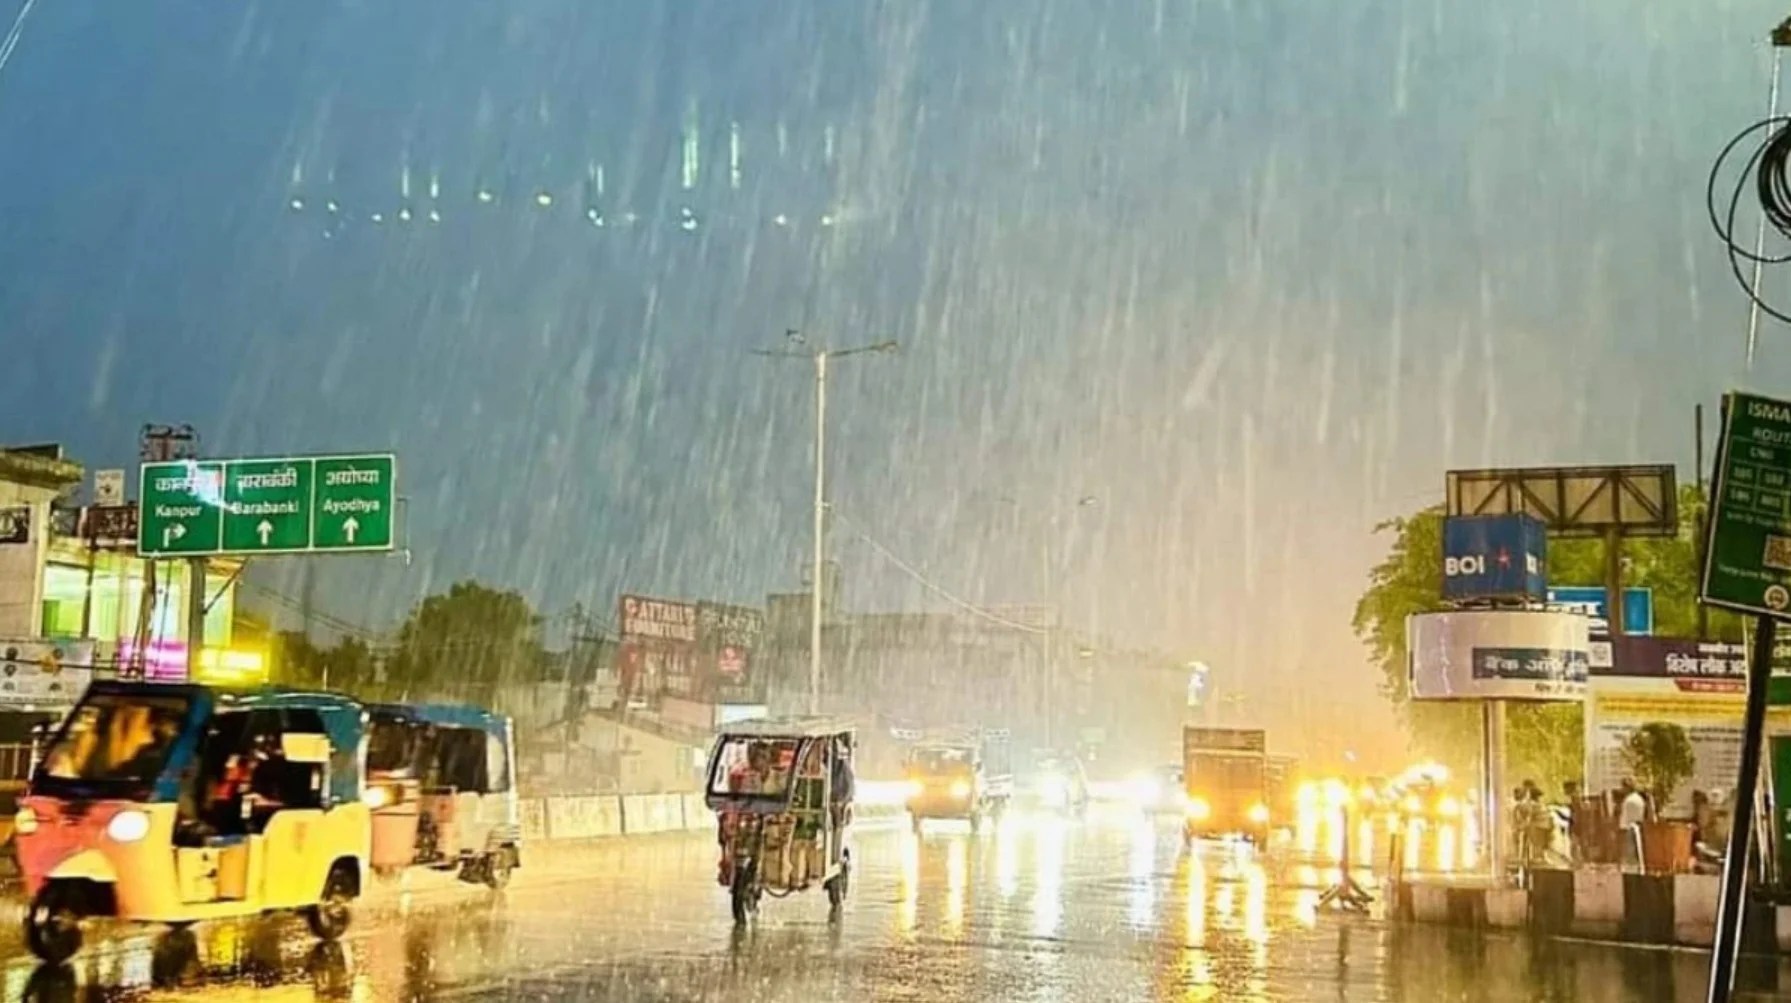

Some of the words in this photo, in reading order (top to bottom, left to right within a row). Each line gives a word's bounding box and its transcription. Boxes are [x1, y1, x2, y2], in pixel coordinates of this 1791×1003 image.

[155, 504, 202, 519] Kanpur
[232, 500, 299, 515] Barabanki
[323, 499, 381, 515] Ayodhya
[1445, 555, 1485, 576] BOI
